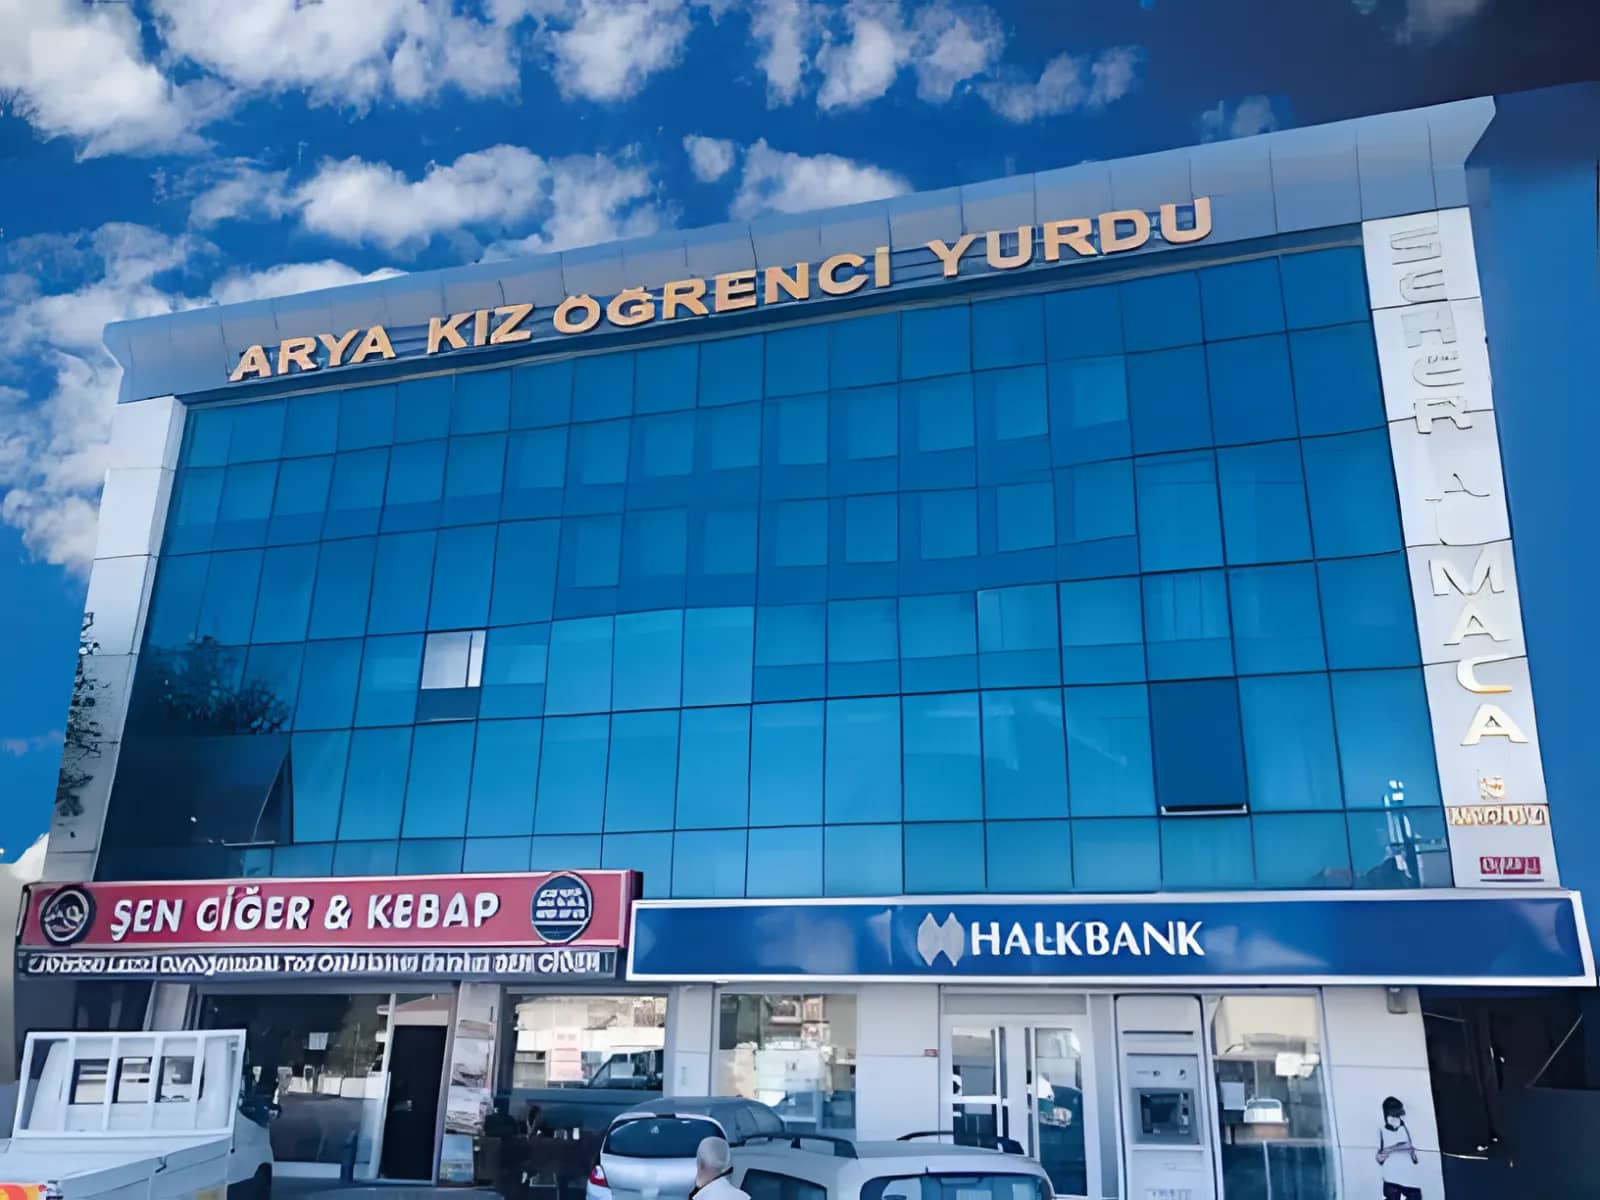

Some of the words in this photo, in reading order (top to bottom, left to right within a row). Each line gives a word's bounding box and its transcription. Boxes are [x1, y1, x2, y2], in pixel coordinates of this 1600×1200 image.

[228, 325, 396, 382] ARYA
[427, 304, 534, 354] KIZ
[552, 246, 891, 334] ÖĞRENCİ
[927, 196, 1212, 278] YURDU
[110, 898, 184, 942] ŞEN
[323, 894, 351, 930] &
[367, 891, 499, 930] KEBAP
[971, 920, 1206, 956] HALKBANK
